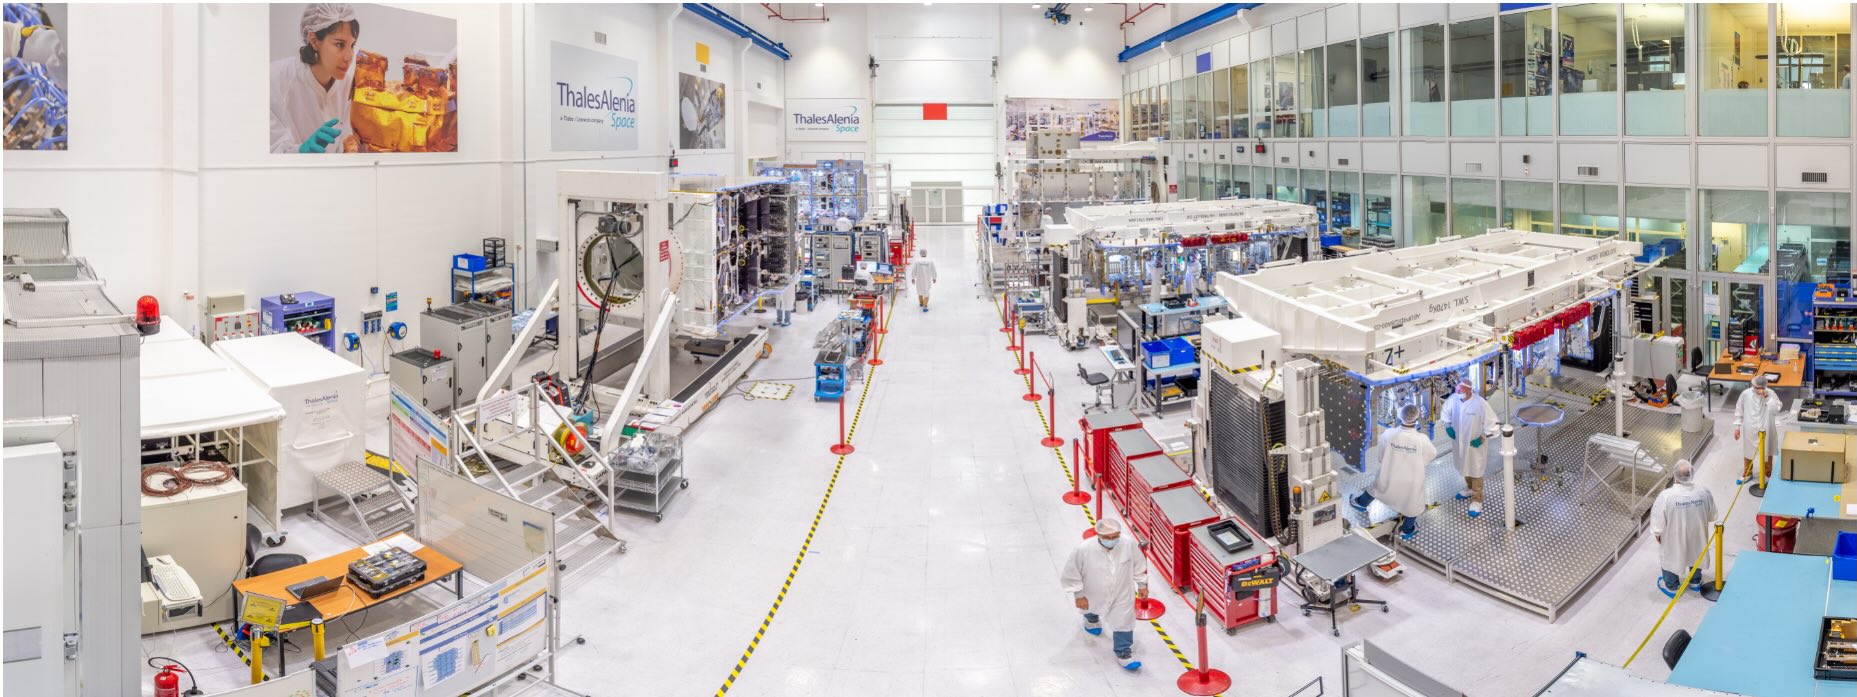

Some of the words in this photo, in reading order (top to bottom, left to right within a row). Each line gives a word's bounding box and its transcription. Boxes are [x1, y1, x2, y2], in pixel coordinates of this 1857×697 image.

[556, 82, 635, 113] ThalesAlenia
[611, 112, 635, 131] Space
[793, 113, 860, 125] ThalesAlenia
[836, 124, 859, 133] Space
